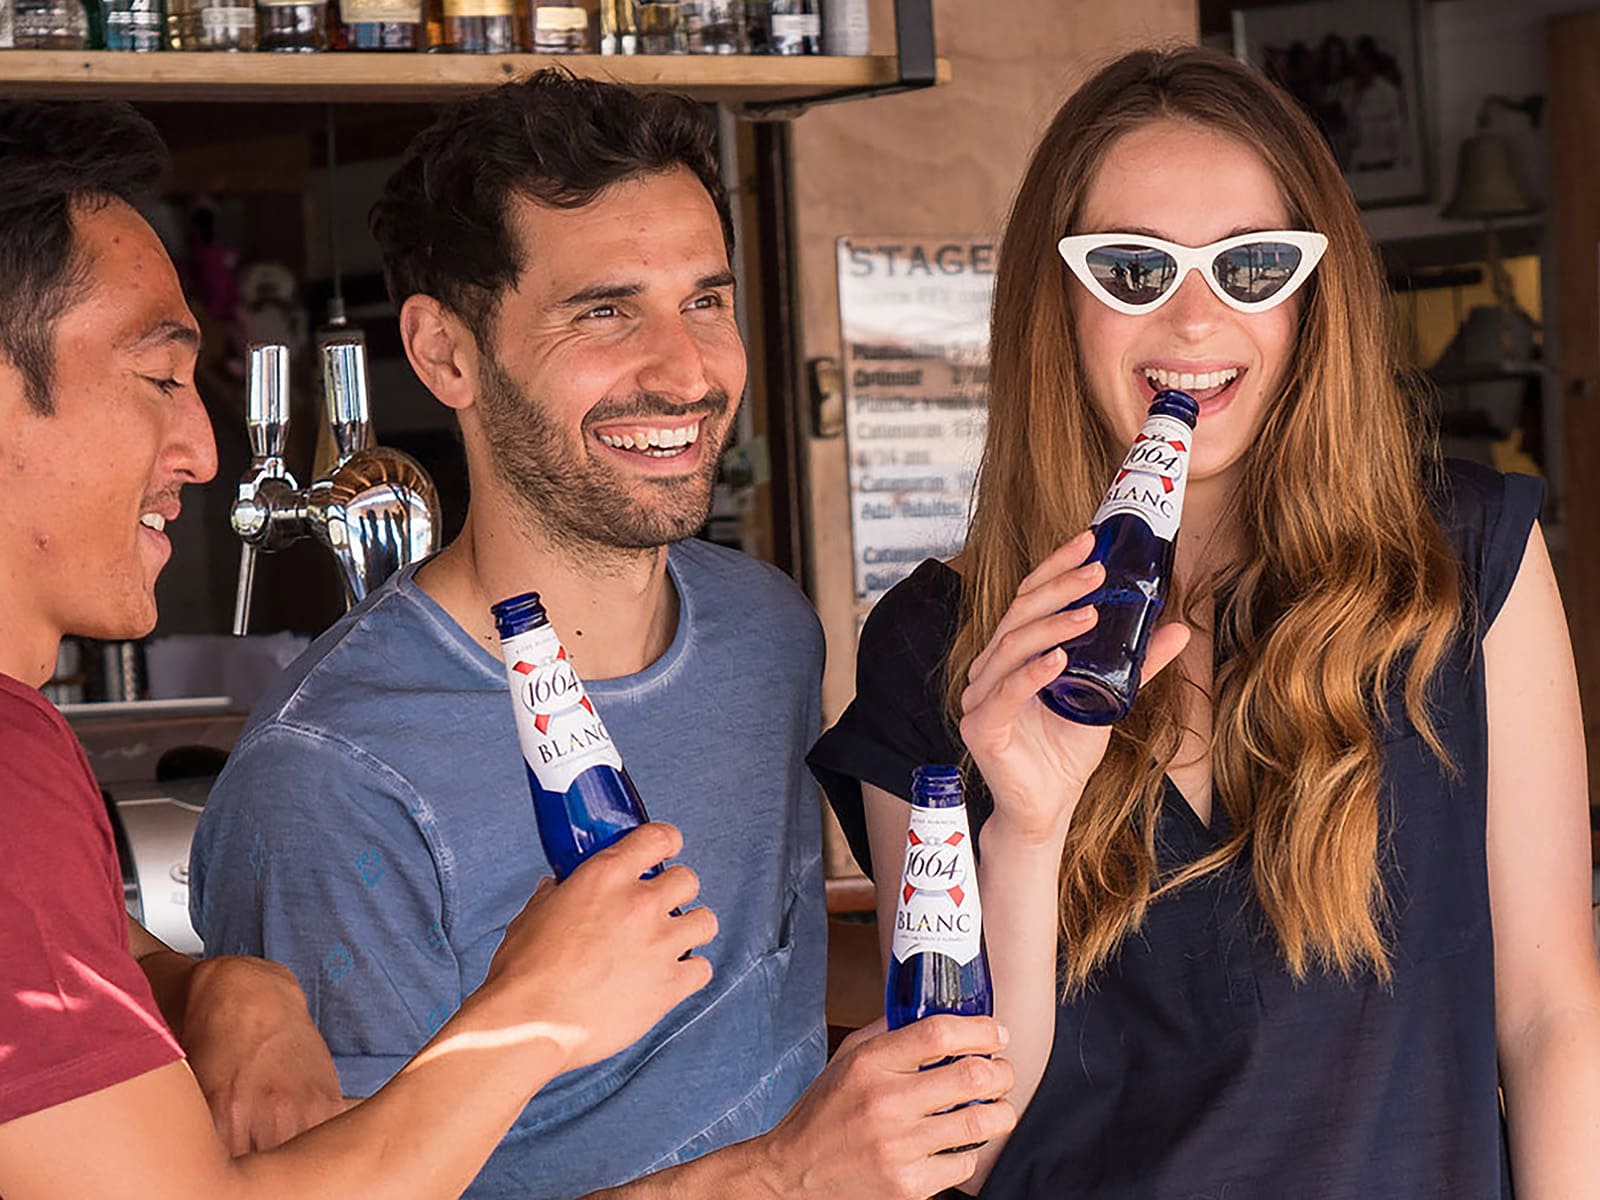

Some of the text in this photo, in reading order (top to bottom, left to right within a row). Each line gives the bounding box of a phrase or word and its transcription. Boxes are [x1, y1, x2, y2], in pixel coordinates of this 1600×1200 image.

[528, 666, 579, 707] 1664
[538, 721, 610, 764] BLANC
[906, 849, 963, 880] 1664
[897, 911, 971, 933] BLANC
